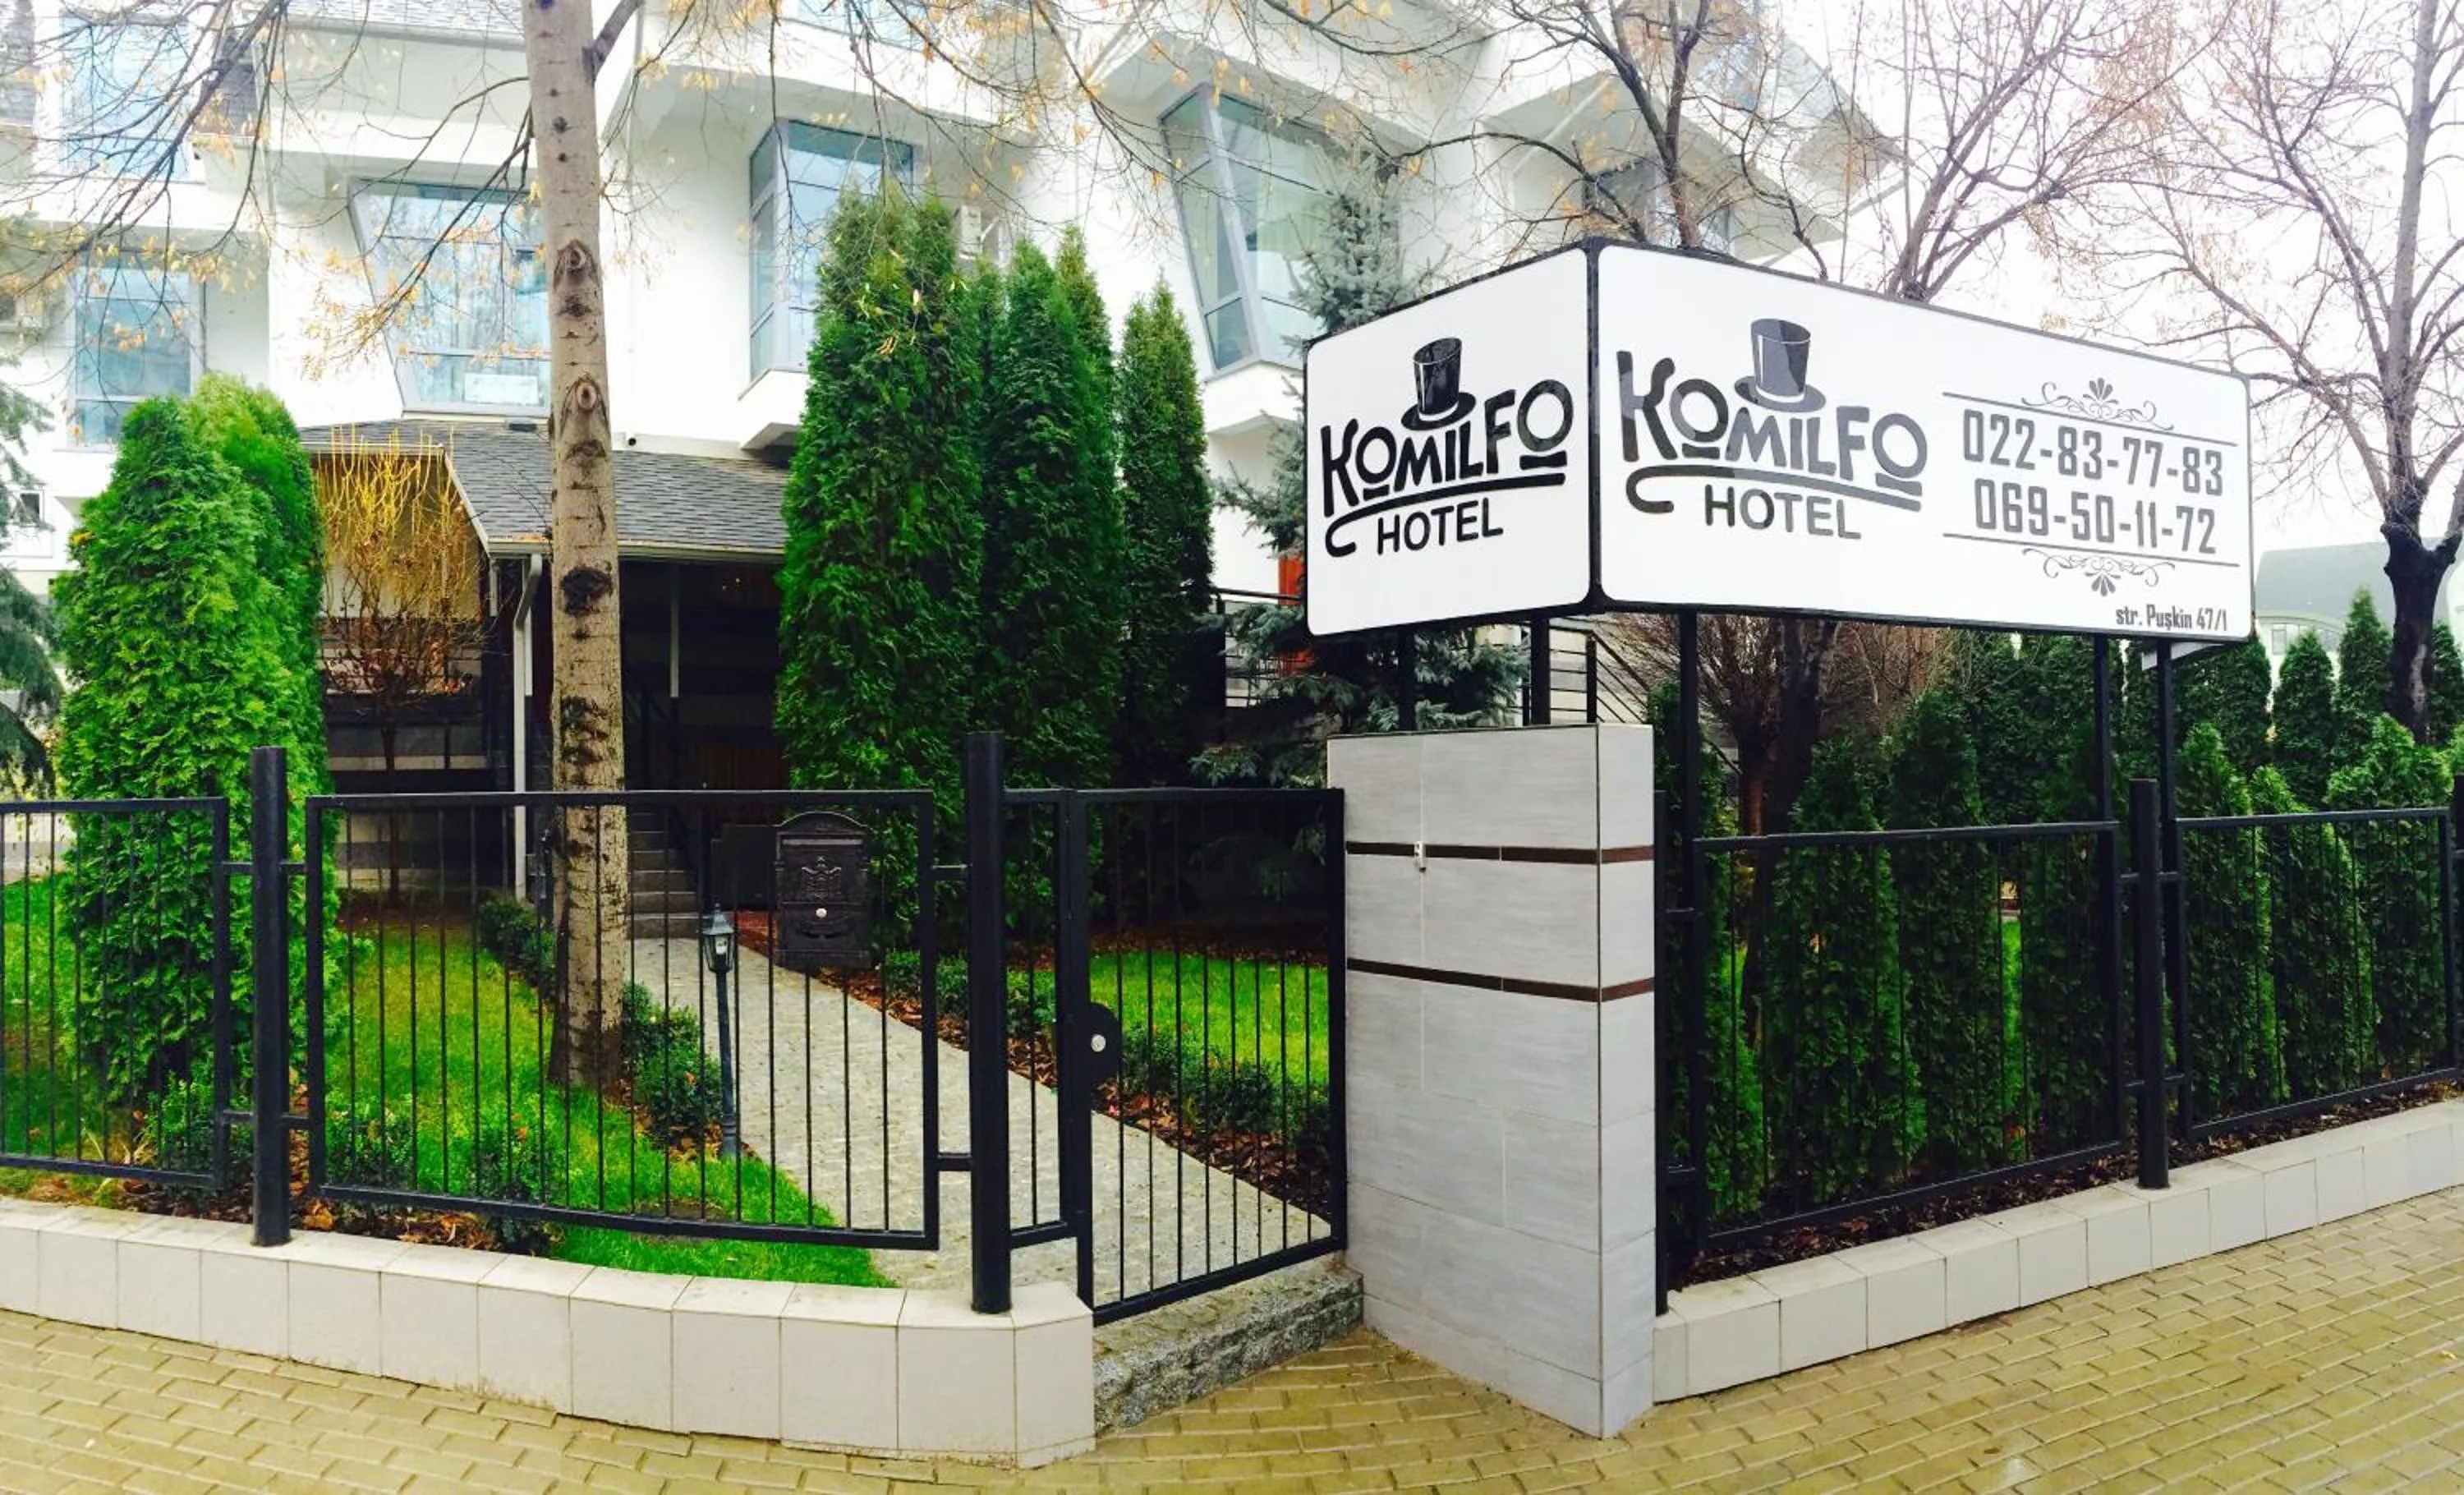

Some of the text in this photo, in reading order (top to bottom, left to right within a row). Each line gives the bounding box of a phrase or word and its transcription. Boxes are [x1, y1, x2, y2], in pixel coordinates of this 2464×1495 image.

[1320, 379, 1574, 518] KOMILFO
[1616, 350, 1928, 481] KOMILFO
[1963, 409, 2223, 496] 022-83-77-83
[1377, 497, 1504, 555] HOTEL
[1704, 484, 1862, 540] HOTEL
[1974, 478, 2216, 554] 069-50-11-72
[2115, 604, 2227, 631] str. Puşkin 47/1
